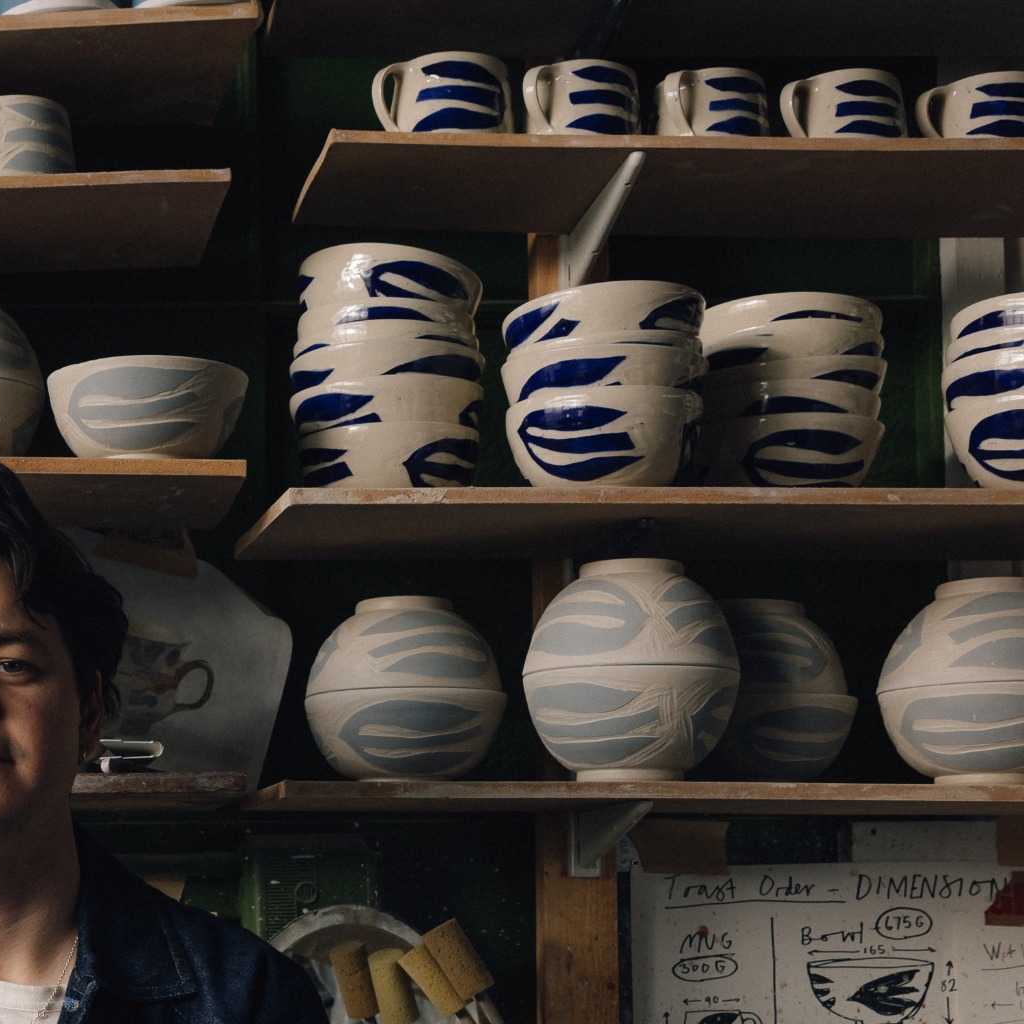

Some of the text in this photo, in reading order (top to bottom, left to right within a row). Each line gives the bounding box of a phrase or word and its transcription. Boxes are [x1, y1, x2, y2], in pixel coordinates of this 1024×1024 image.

[664, 873, 736, 900] Toast
[760, 874, 815, 897] Order
[680, 932, 732, 953] MUG
[801, 922, 863, 946] Bowl
[864, 945, 885, 954] 165
[941, 979, 957, 992] 82
[705, 996, 719, 1006] 90
